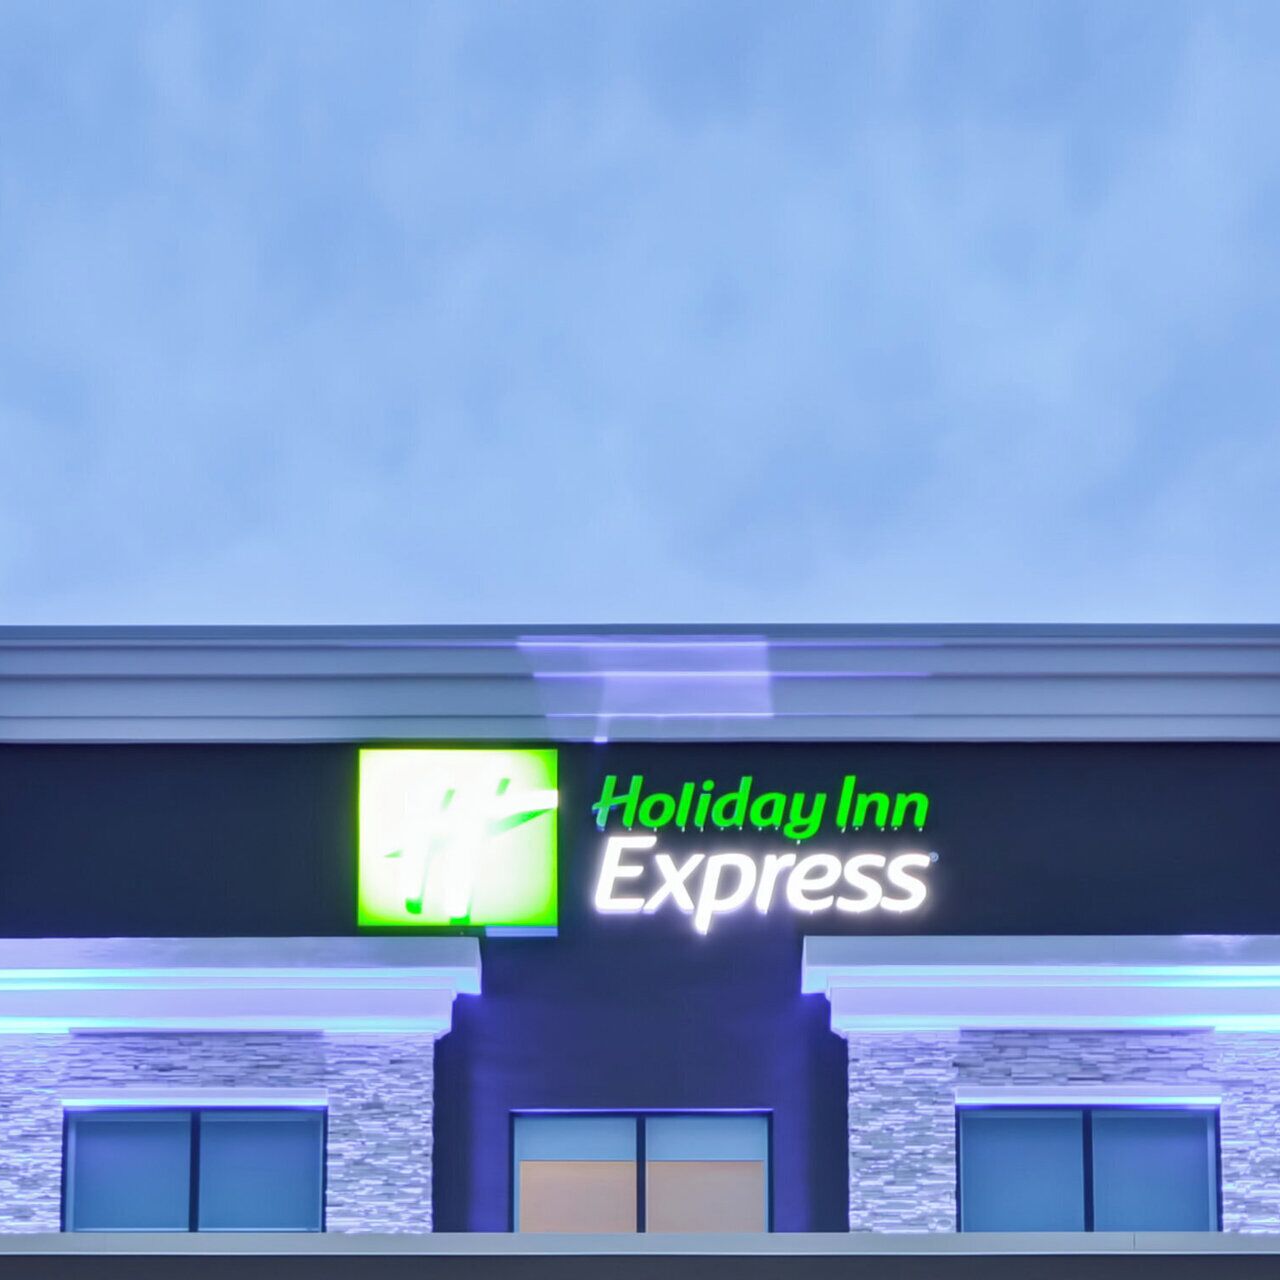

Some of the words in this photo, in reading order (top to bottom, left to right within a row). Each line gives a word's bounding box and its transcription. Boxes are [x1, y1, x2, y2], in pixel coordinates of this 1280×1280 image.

[592, 775, 827, 840] Holiday
[836, 775, 929, 828] Inn
[595, 835, 930, 935] Express
